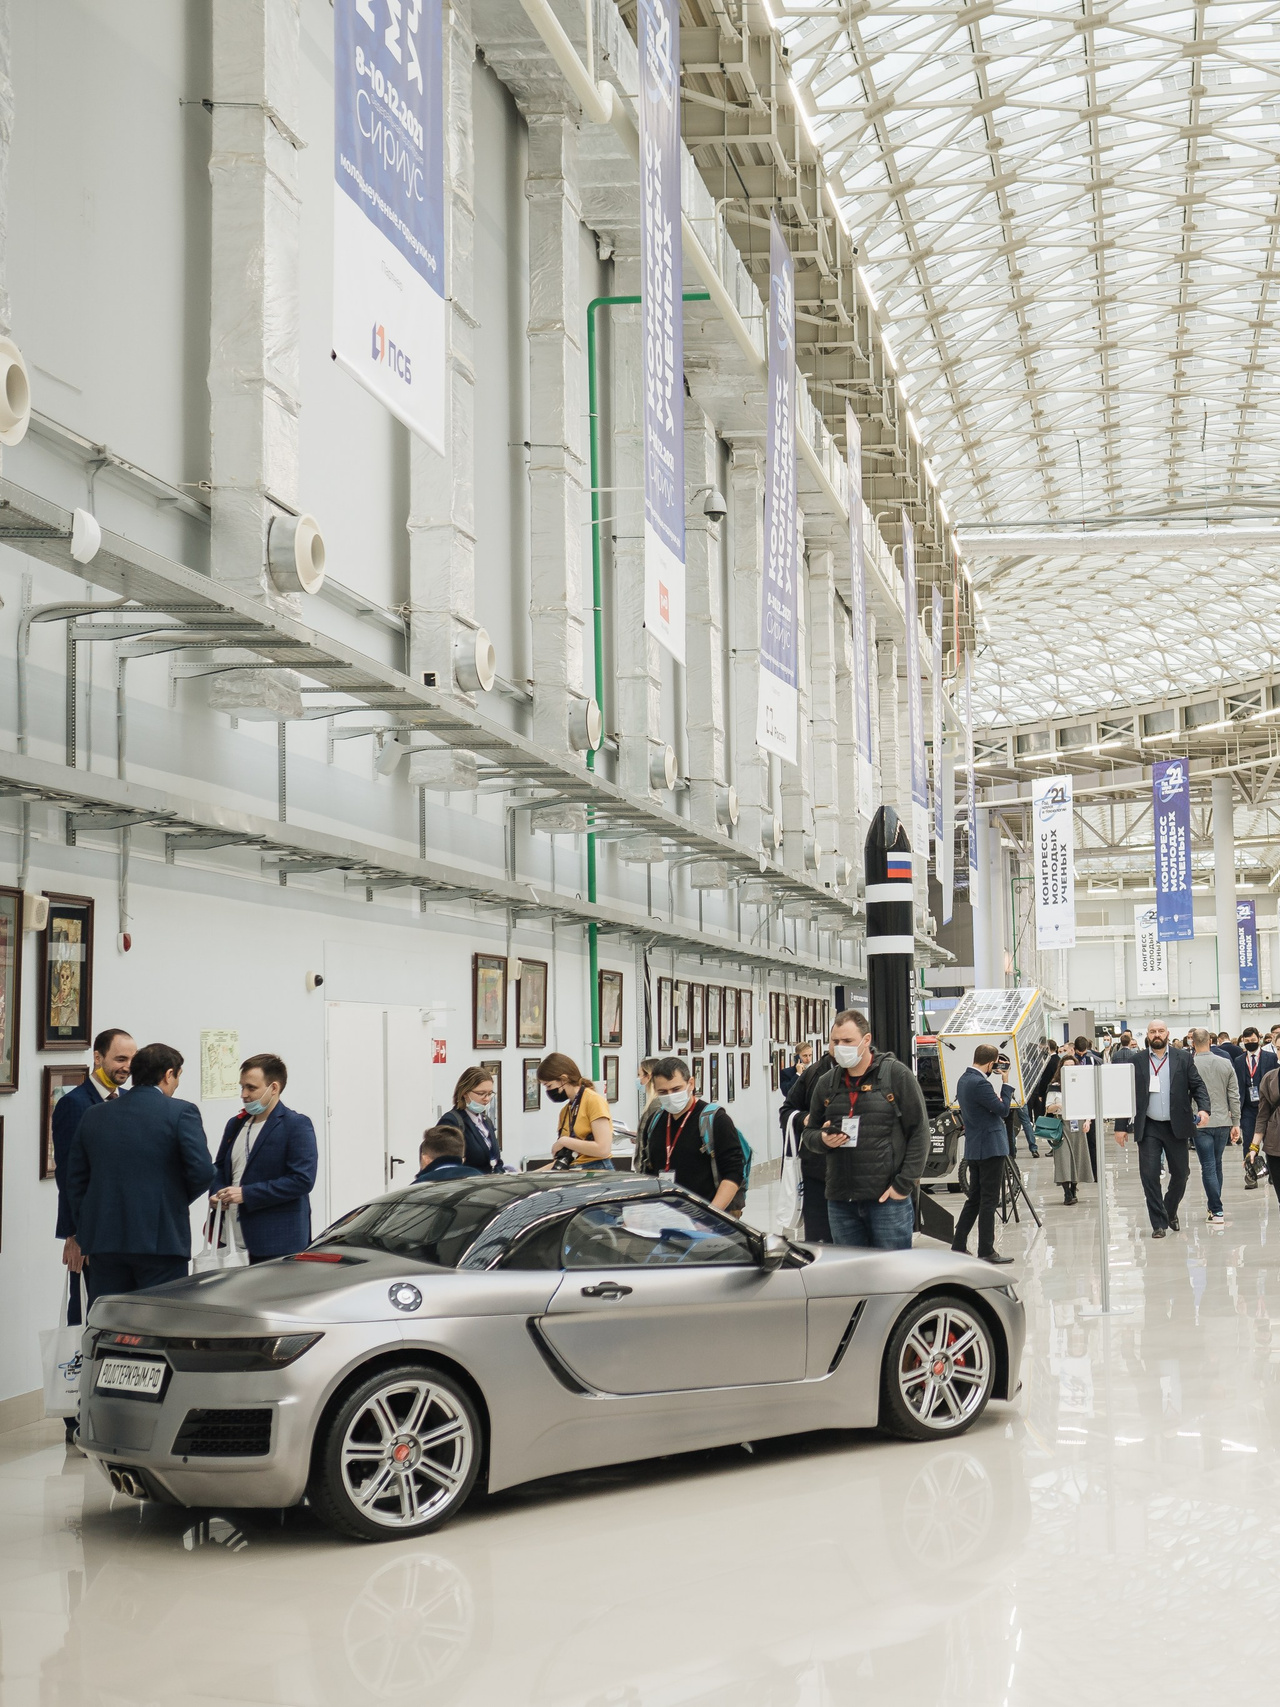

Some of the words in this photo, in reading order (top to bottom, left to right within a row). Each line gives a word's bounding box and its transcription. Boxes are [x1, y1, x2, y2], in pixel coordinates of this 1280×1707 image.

[356, 89, 424, 202] Сириус
[645, 131, 656, 411] КОНГРЕСС
[654, 136, 664, 425] МОЛОДЫХ
[388, 338, 412, 386] ПСБ
[663, 211, 675, 438] УЧЕНЫХ
[1041, 833, 1050, 906] КОНГРЕСС
[1050, 829, 1059, 905] МОЛОДЫХ
[1060, 843, 1068, 904] УЧЕНЫХ
[1159, 815, 1169, 893] КОНГРЕСС
[1168, 811, 1178, 892] МОЛОДЫХ
[1178, 825, 1187, 891] УЧЕНЫХ
[1238, 927, 1246, 968] МОЛОДЫХ
